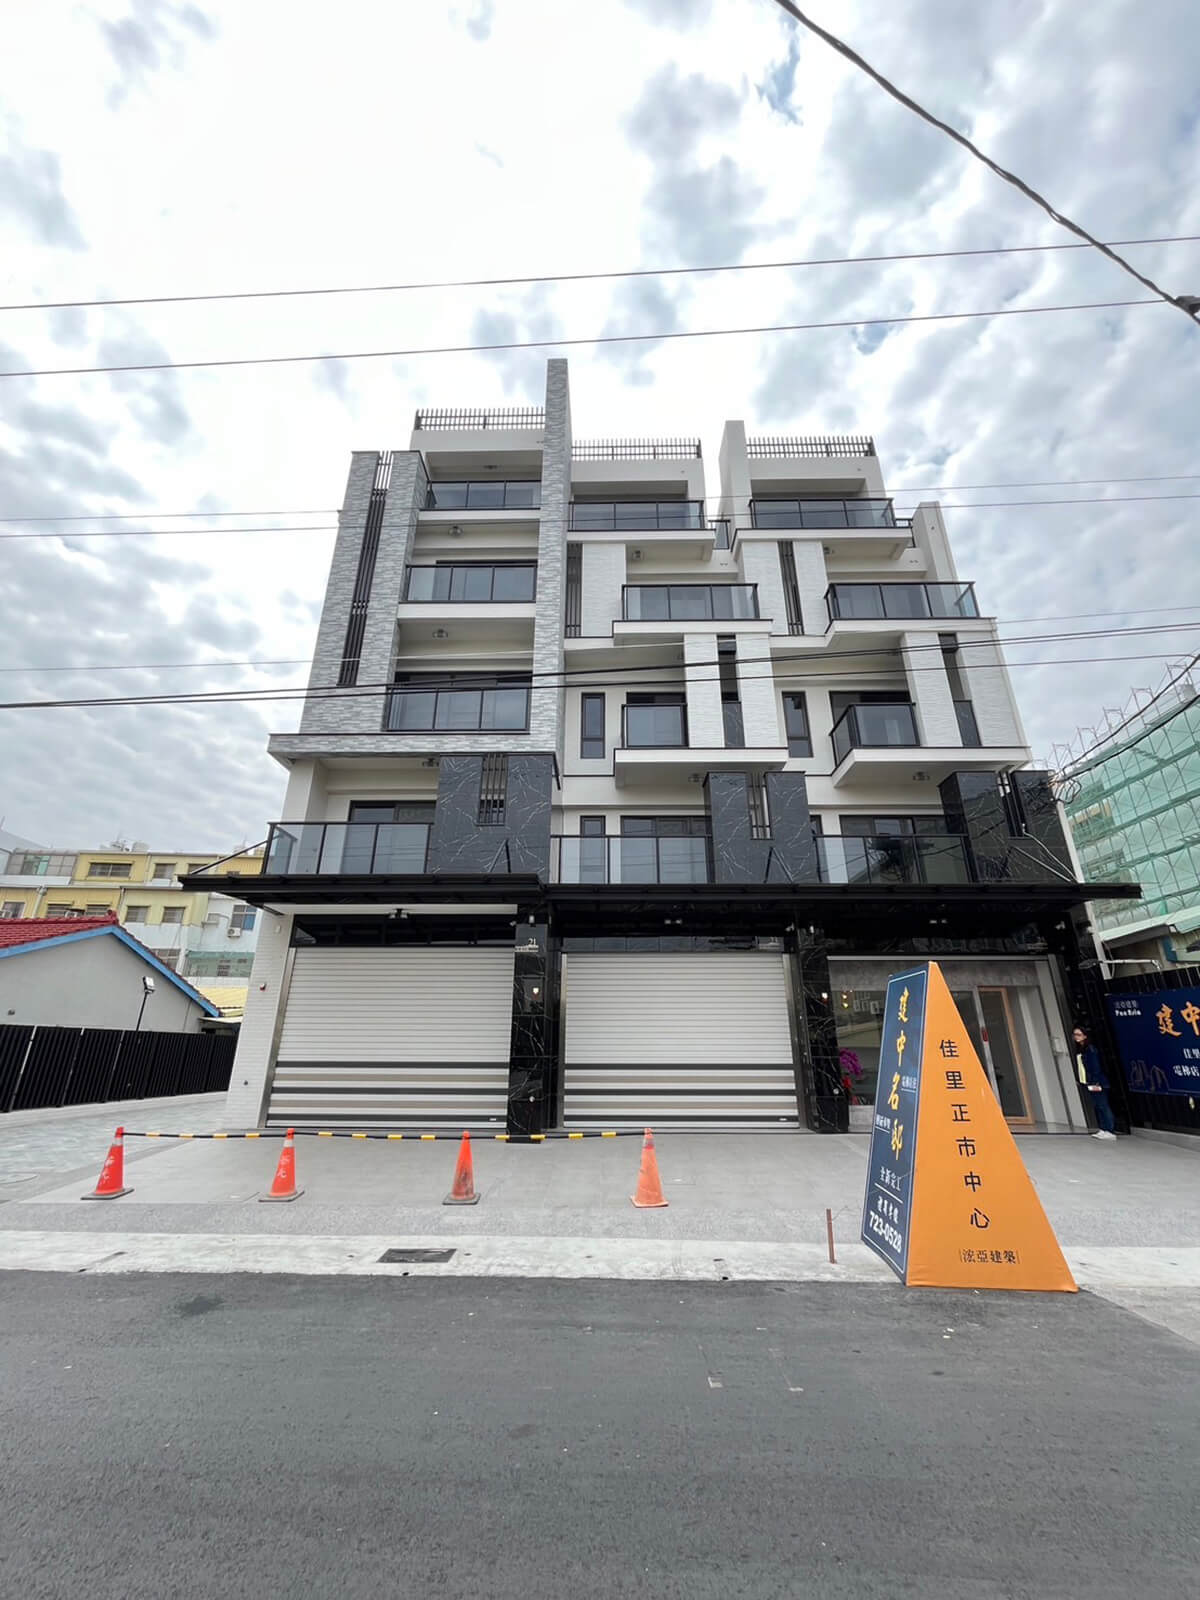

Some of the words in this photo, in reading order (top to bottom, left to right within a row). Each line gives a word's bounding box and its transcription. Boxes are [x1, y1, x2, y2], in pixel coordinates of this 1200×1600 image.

[939, 1039, 990, 1229] 佳里正市中心
[869, 1210, 902, 1253] 723-0528
